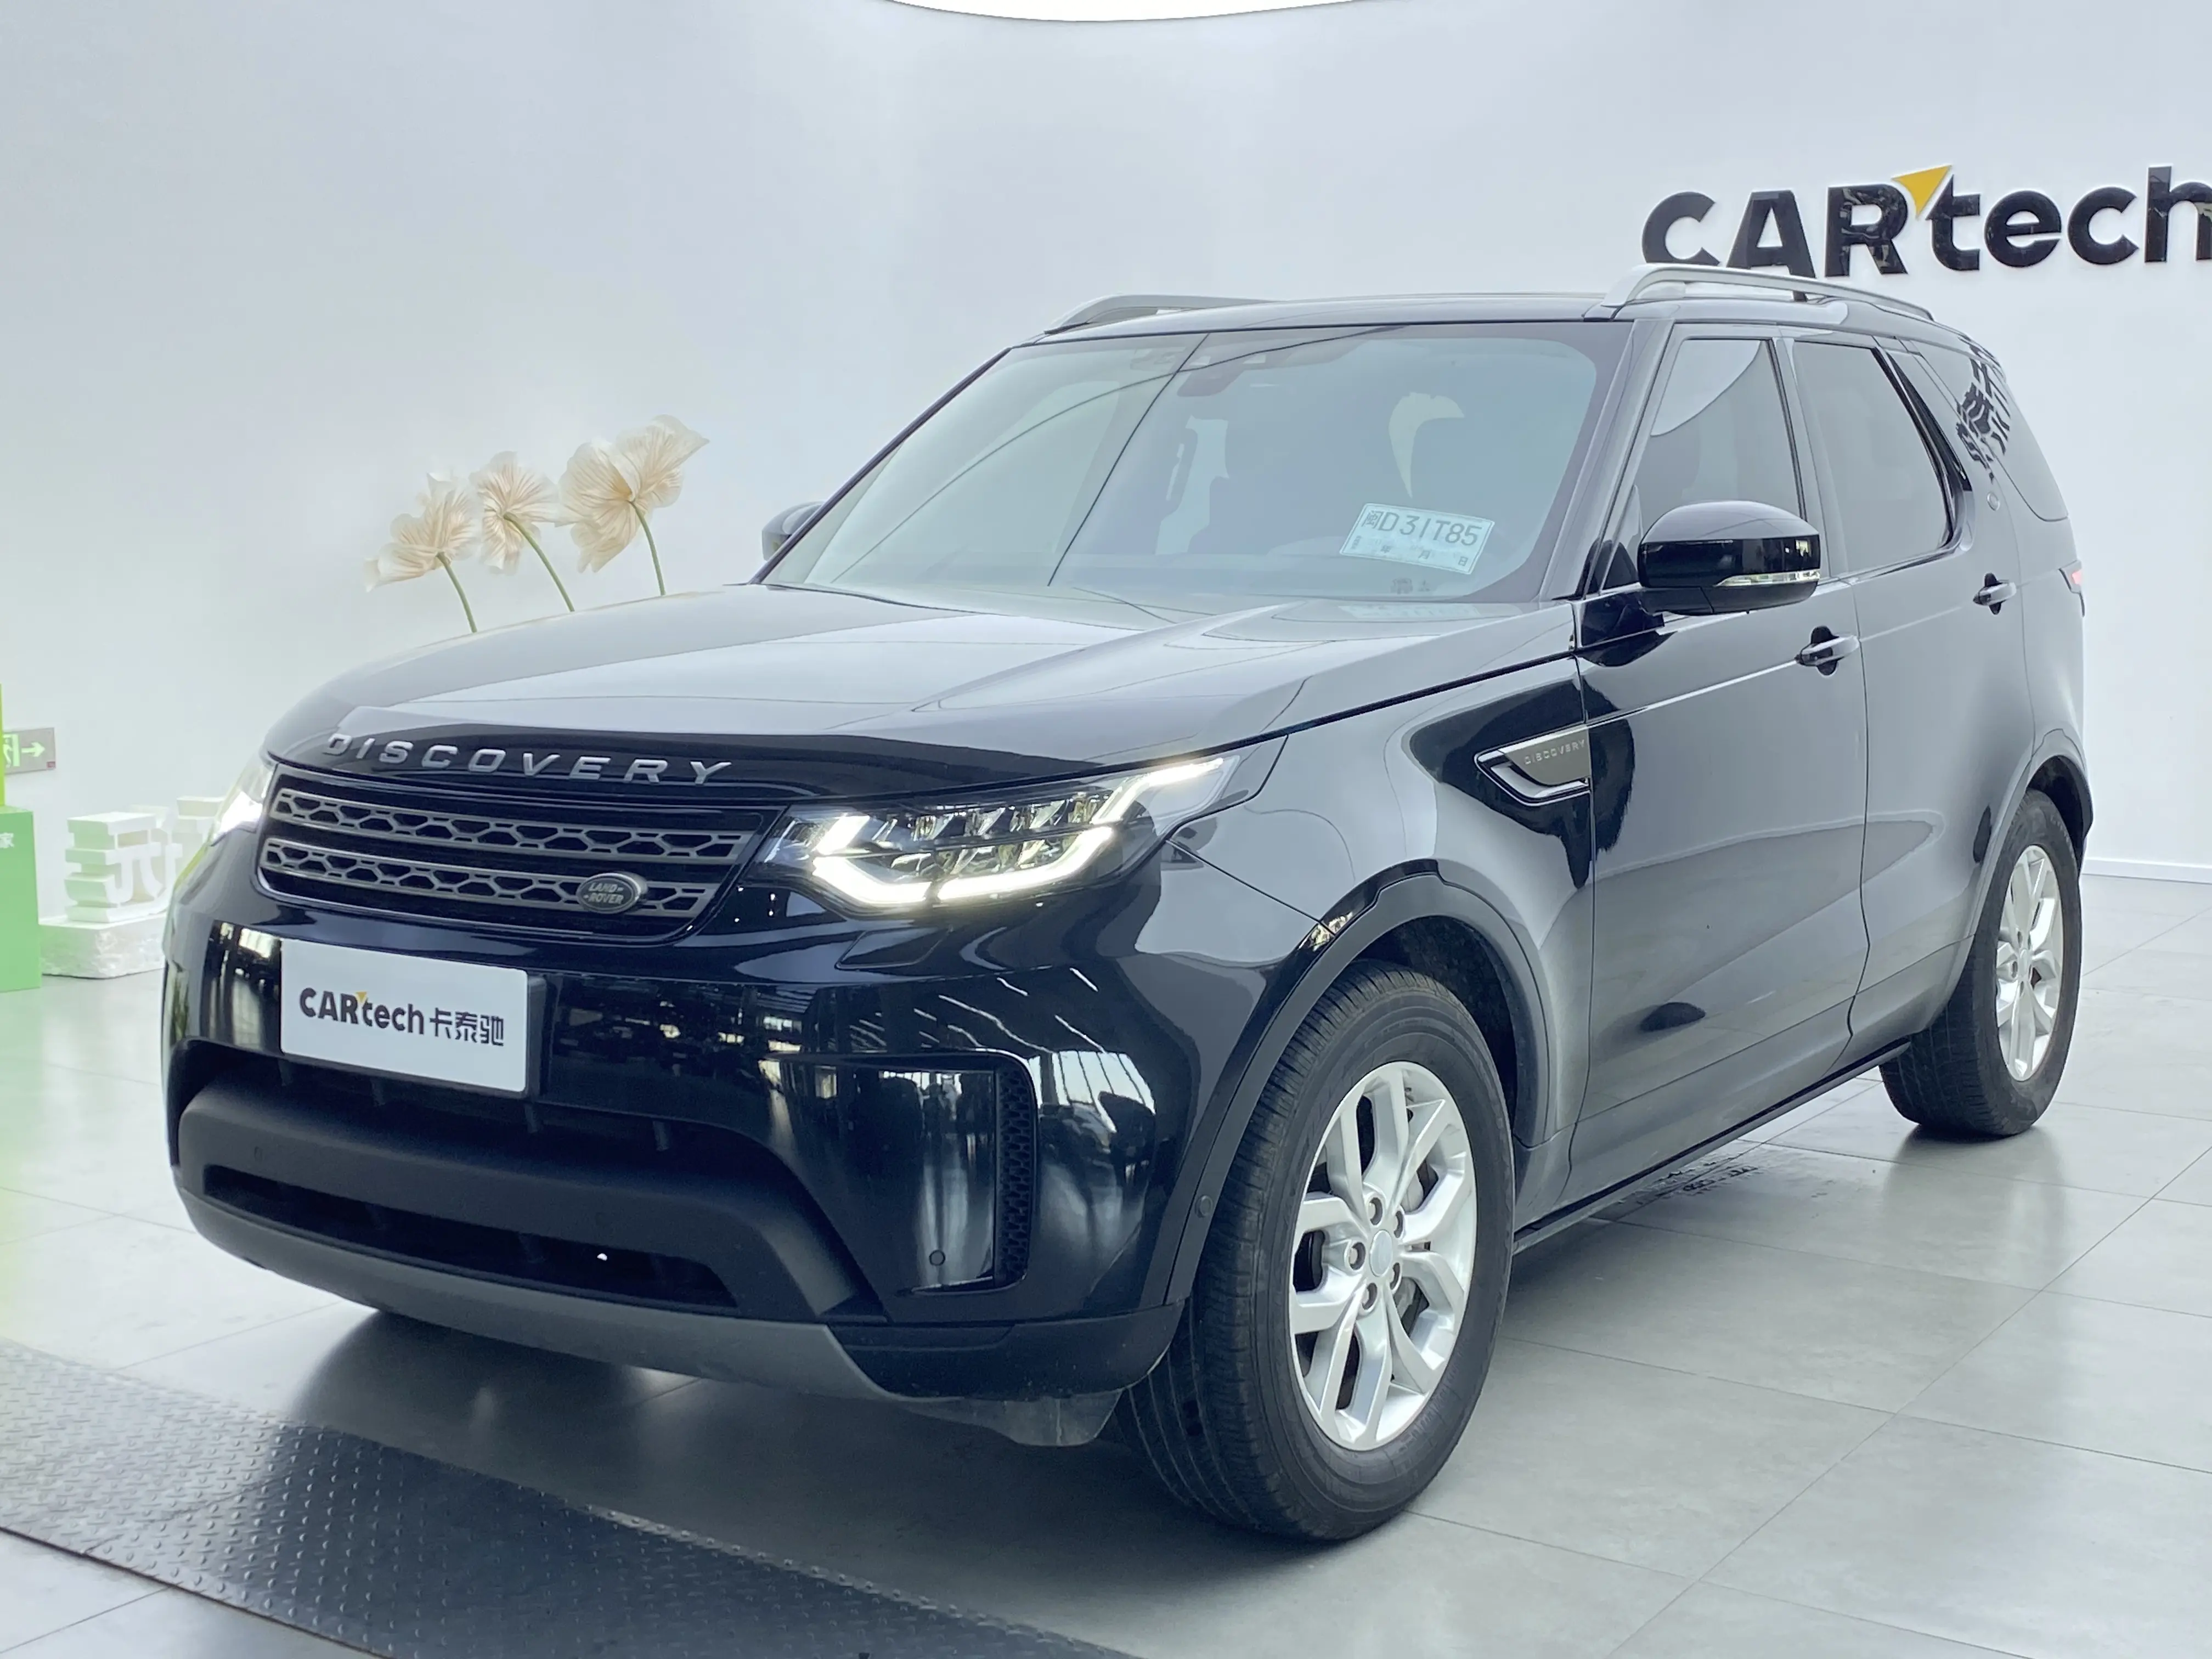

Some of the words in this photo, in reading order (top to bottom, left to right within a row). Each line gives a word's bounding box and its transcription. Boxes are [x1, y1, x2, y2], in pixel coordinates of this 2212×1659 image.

[1641, 165, 2212, 300] CARtech
[323, 733, 733, 787] DISCOVERY
[1525, 740, 1585, 764] DISCOVERY
[588, 883, 618, 893] LAND
[588, 893, 624, 904] ROVER
[299, 987, 424, 1035] CARtech
[430, 1007, 504, 1046] 卡泰驰
